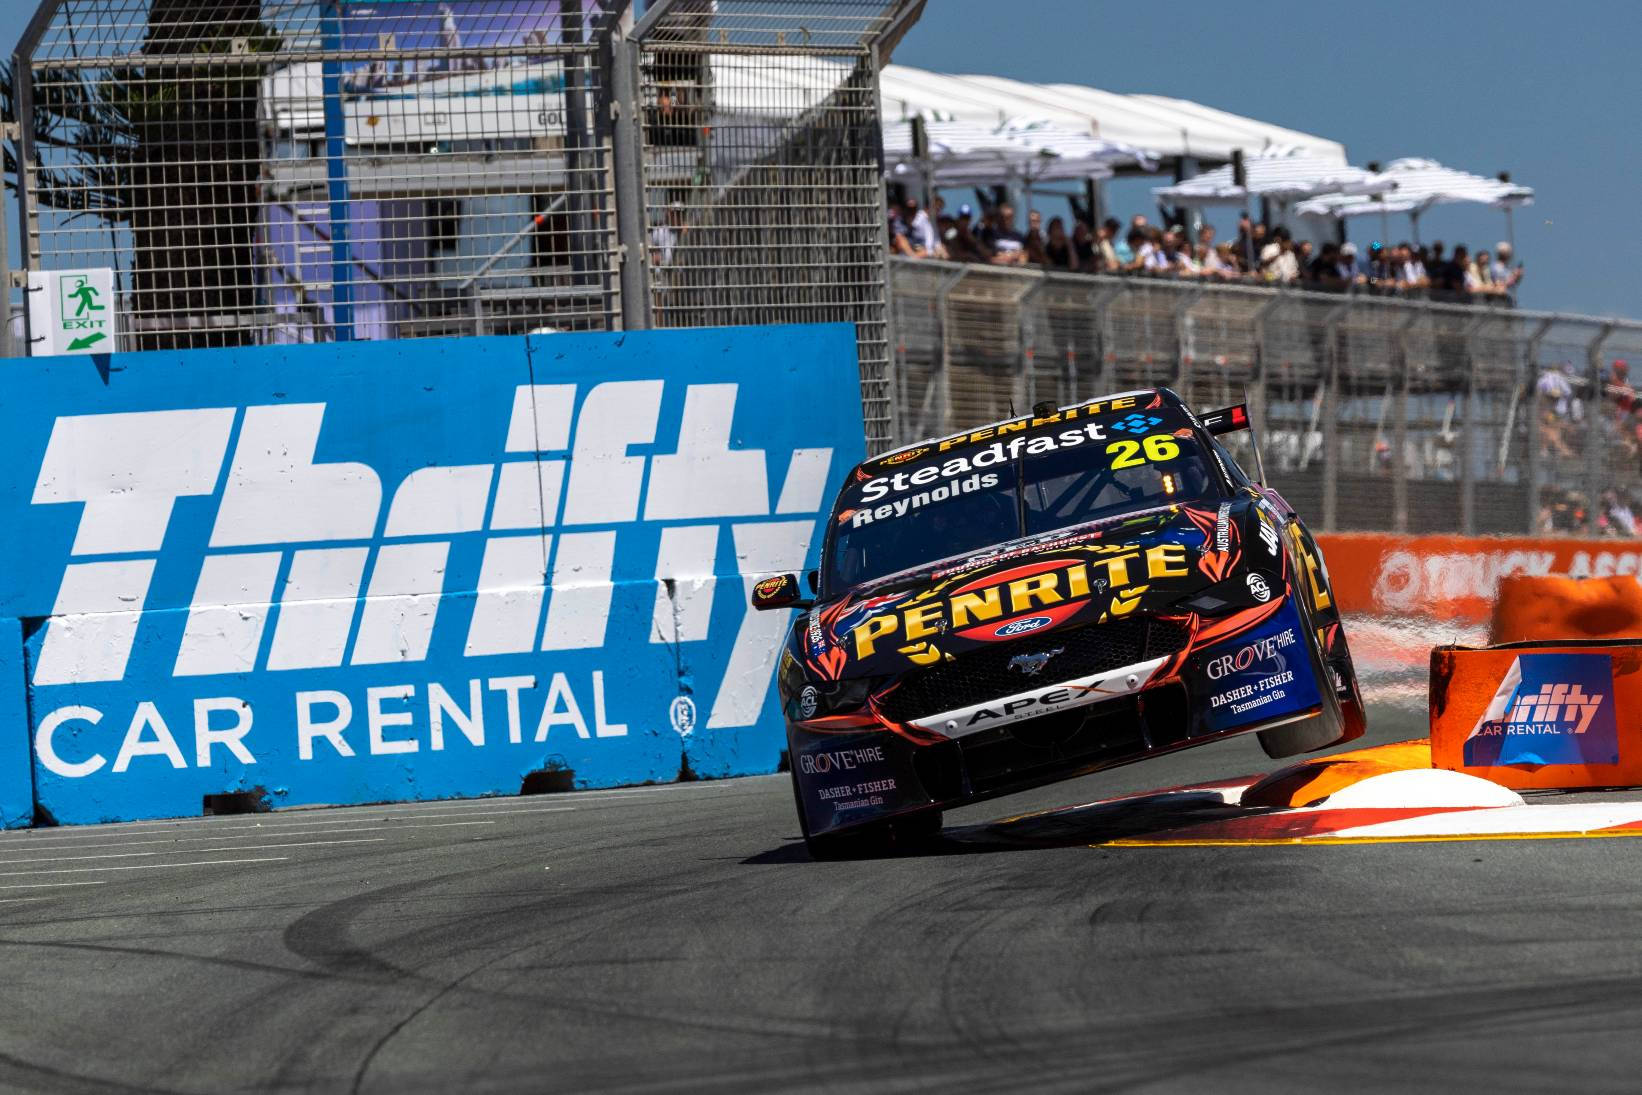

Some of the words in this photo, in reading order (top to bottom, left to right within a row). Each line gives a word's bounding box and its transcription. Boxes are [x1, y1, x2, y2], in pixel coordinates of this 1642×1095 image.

[63, 320, 106, 330] EXIT
[939, 397, 1136, 452] PENRITE
[860, 422, 1107, 503] Steadfast
[1105, 434, 1180, 470] 26
[852, 473, 998, 529] Reynolds
[31, 379, 834, 730] Thrifty
[755, 578, 788, 592] PENRITE
[855, 544, 1189, 660] PENRITE
[1207, 637, 1277, 680] GROVE
[1277, 628, 1296, 650] HIRE
[966, 679, 1119, 726] APEX
[1211, 685, 1254, 708] DASHER
[1259, 670, 1294, 692] FISHER
[1230, 694, 1273, 715] Tasmanian
[1272, 689, 1286, 703] Gin
[34, 696, 257, 778] CAR
[296, 671, 627, 761] RENTAL
[1013, 704, 1065, 720] STEEL
[1504, 684, 1603, 734] rifty
[1507, 723, 1560, 735] RENTAL
[800, 750, 856, 775] GROVE
[856, 746, 885, 764] HIRE
[818, 785, 853, 800] DASHER
[857, 778, 897, 794] FISHER
[833, 799, 869, 811] Tasmanian
[870, 796, 883, 806] Gin
